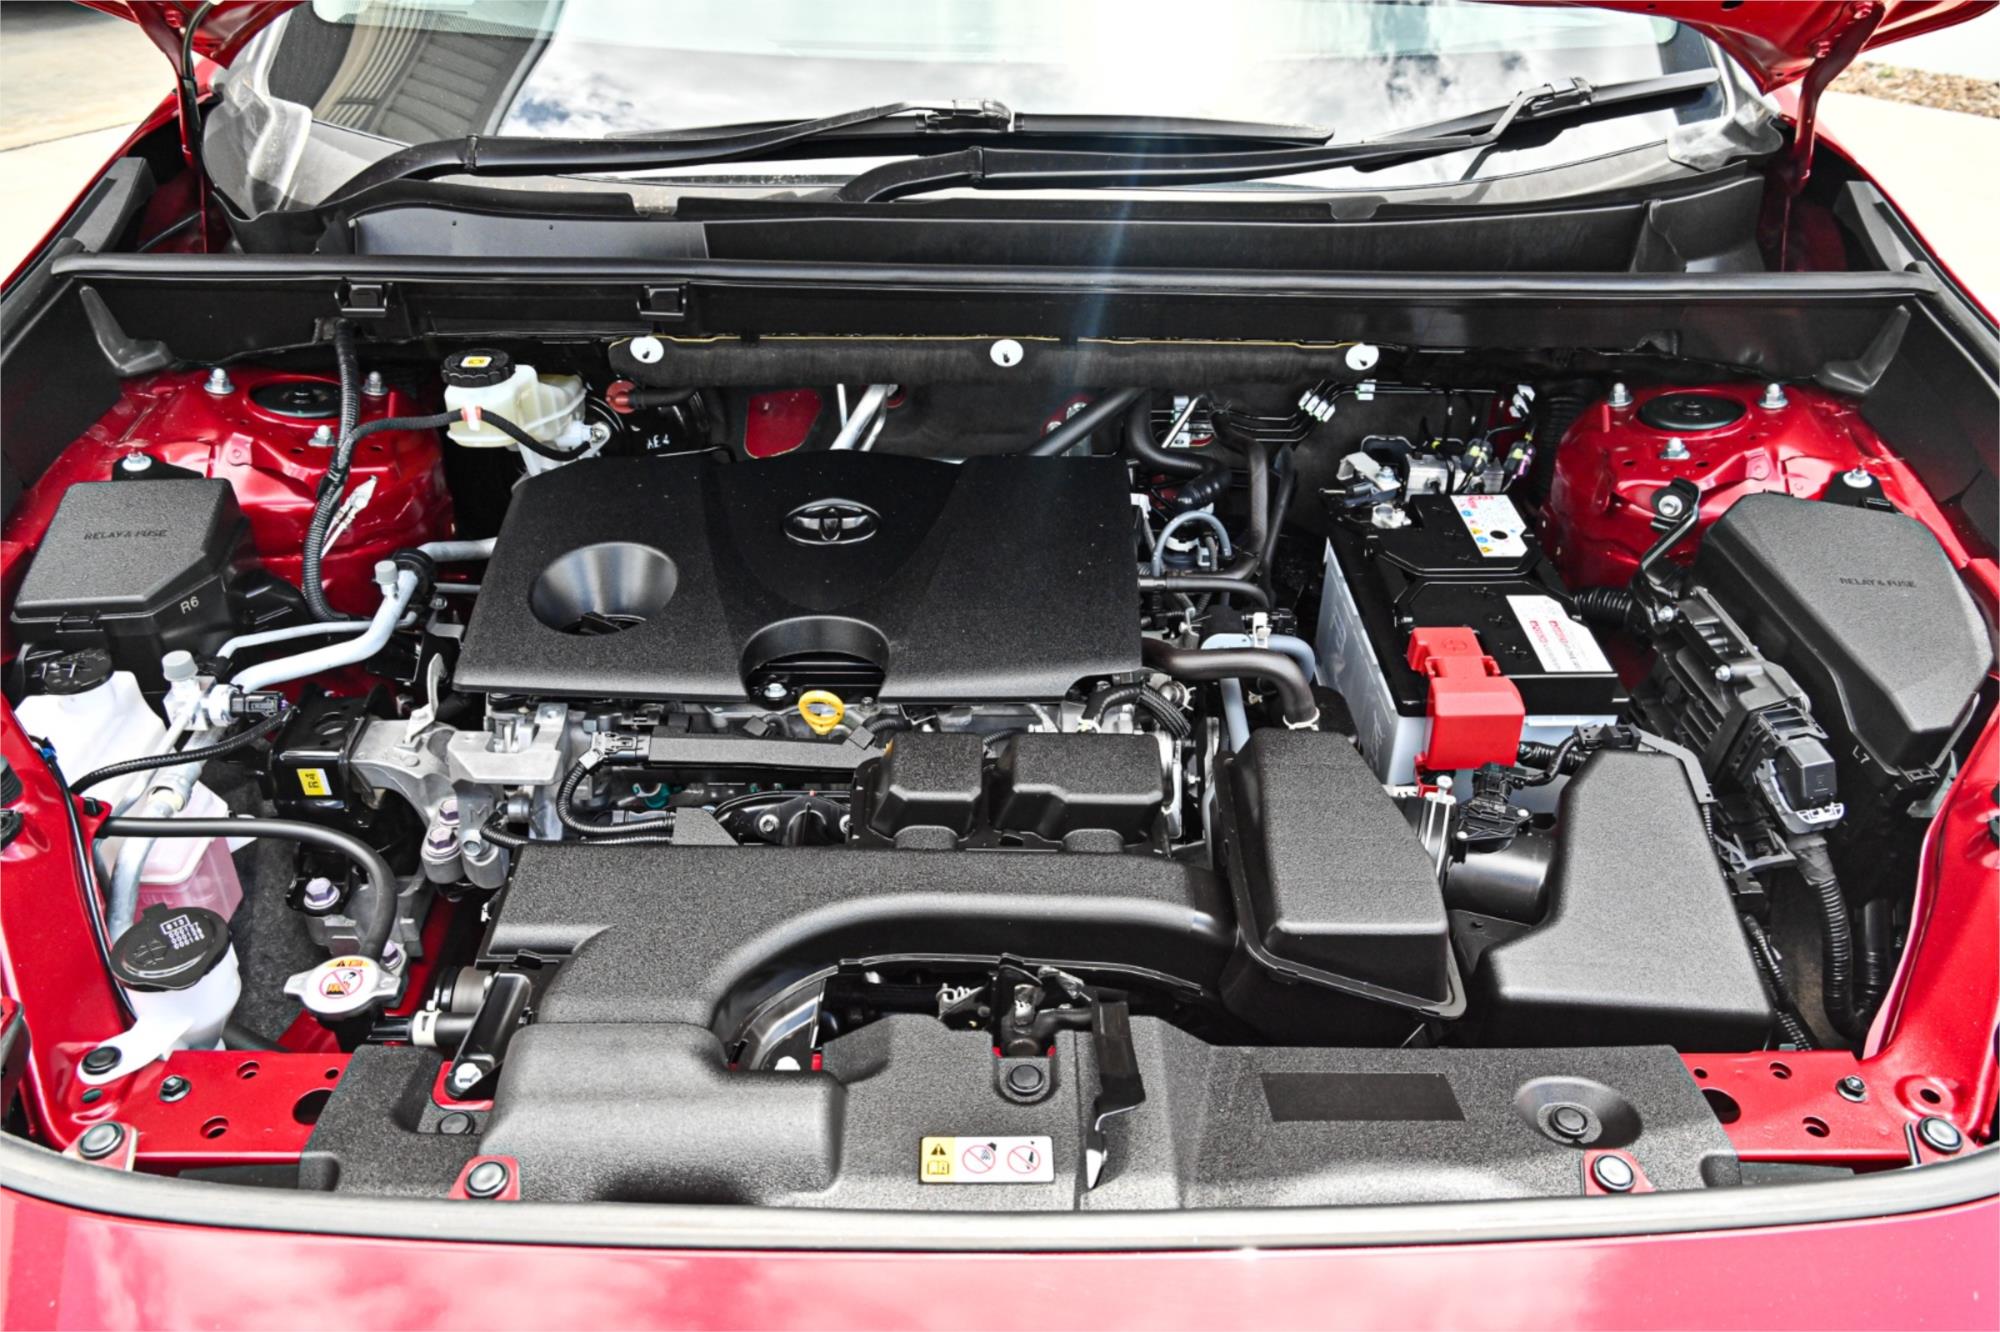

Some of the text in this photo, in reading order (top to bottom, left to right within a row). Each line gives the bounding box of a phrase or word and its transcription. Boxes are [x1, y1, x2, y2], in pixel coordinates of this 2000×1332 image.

[84, 530, 124, 540] RELAY
[135, 529, 168, 538] FUSE
[1839, 577, 1875, 586] RELAY
[1887, 580, 1917, 588] FUSE
[180, 595, 200, 614] R6
[1852, 744, 1871, 764] L7
